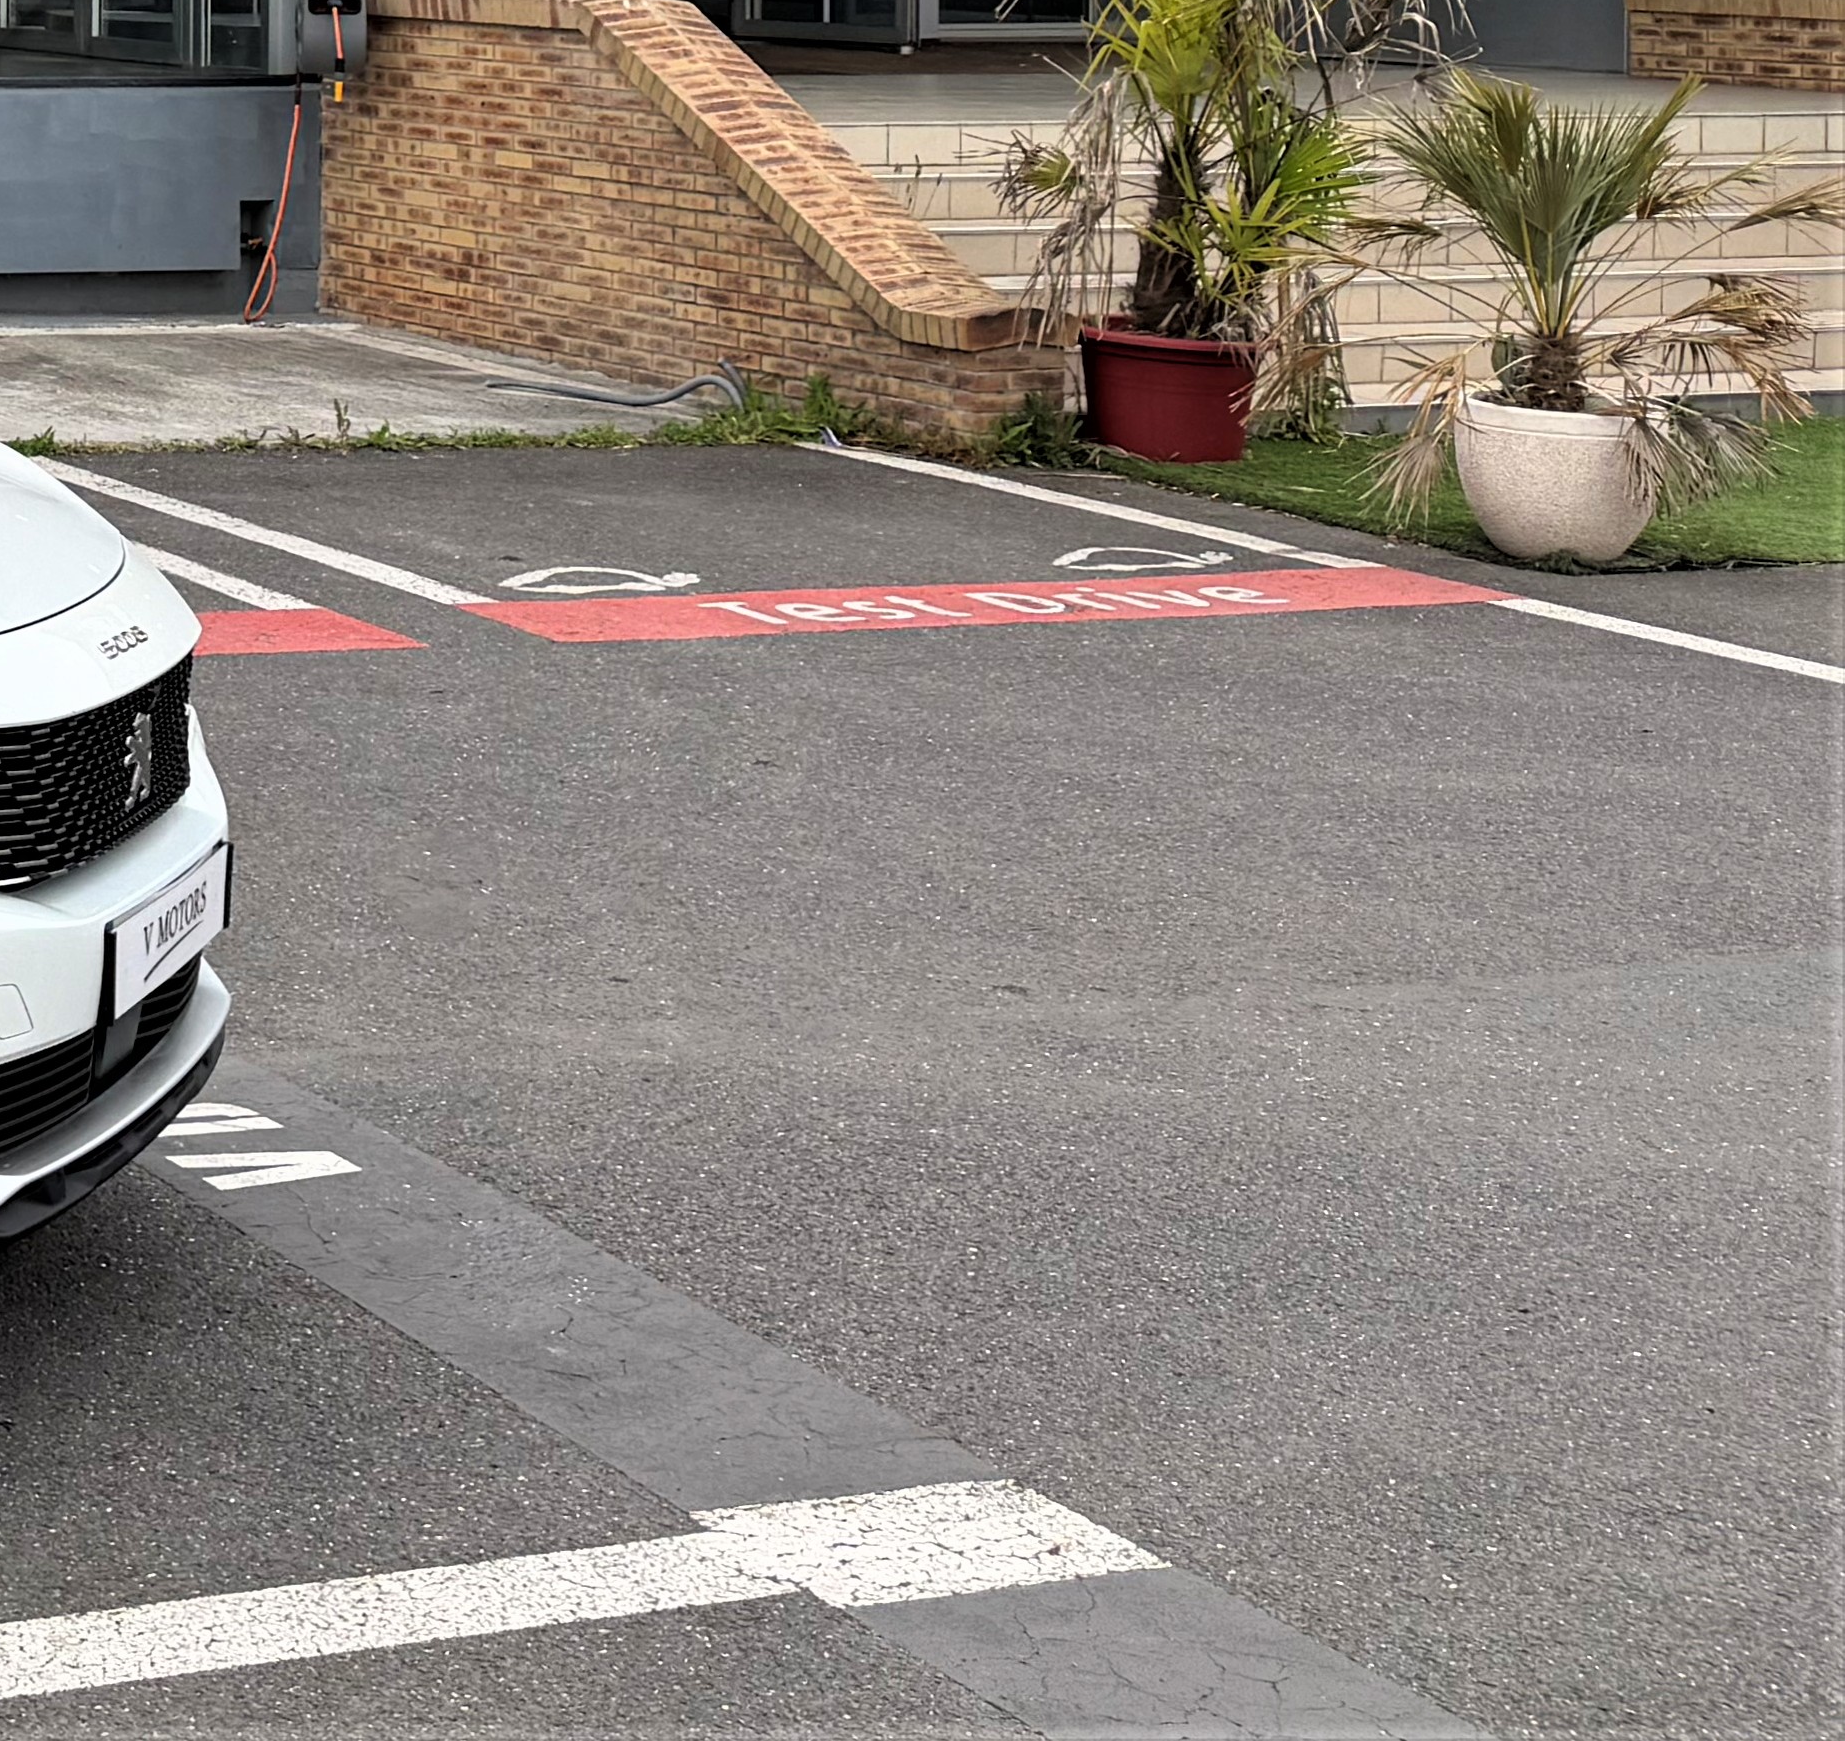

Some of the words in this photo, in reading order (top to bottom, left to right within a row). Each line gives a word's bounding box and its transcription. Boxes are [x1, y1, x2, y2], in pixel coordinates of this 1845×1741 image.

[697, 594, 973, 626] Test
[964, 585, 1291, 615] Drive
[96, 625, 149, 660] 5008
[143, 924, 155, 955] V
[157, 880, 207, 949] MOTORS
